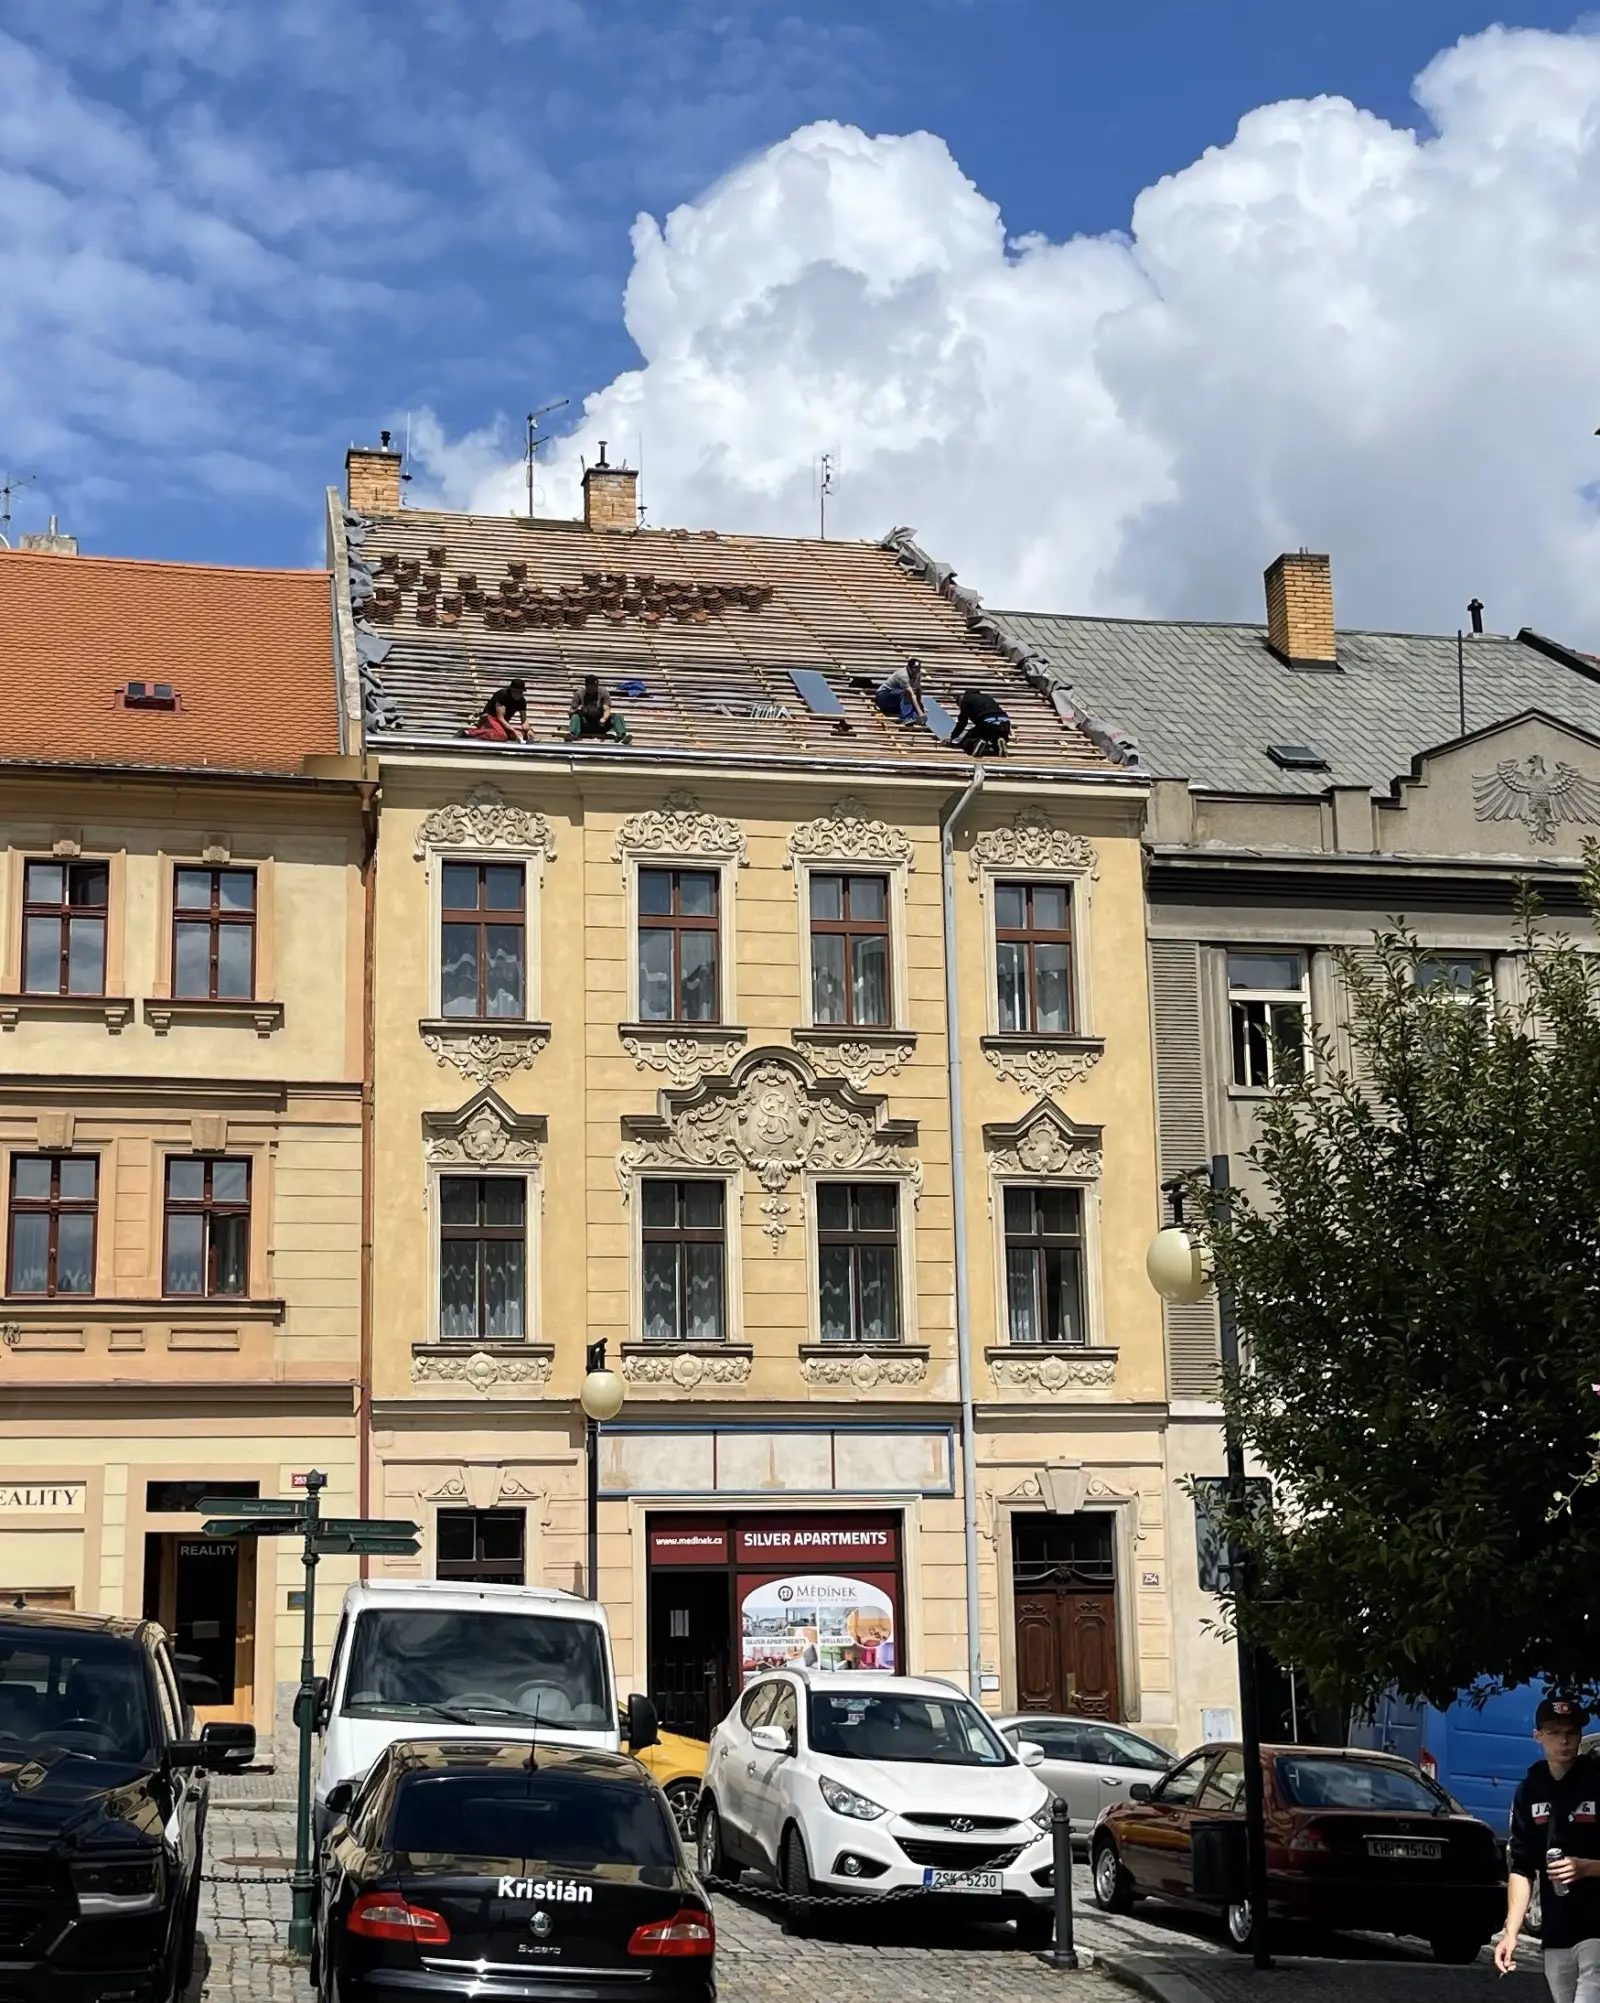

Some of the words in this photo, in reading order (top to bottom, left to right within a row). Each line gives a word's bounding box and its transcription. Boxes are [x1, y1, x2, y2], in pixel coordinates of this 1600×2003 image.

[744, 1533, 791, 1546] SILVER
[793, 1532, 887, 1545] APARTMENTS
[180, 1545, 237, 1556] REALITY
[966, 1872, 997, 1888] 5230
[498, 1876, 593, 1903] Kristián
